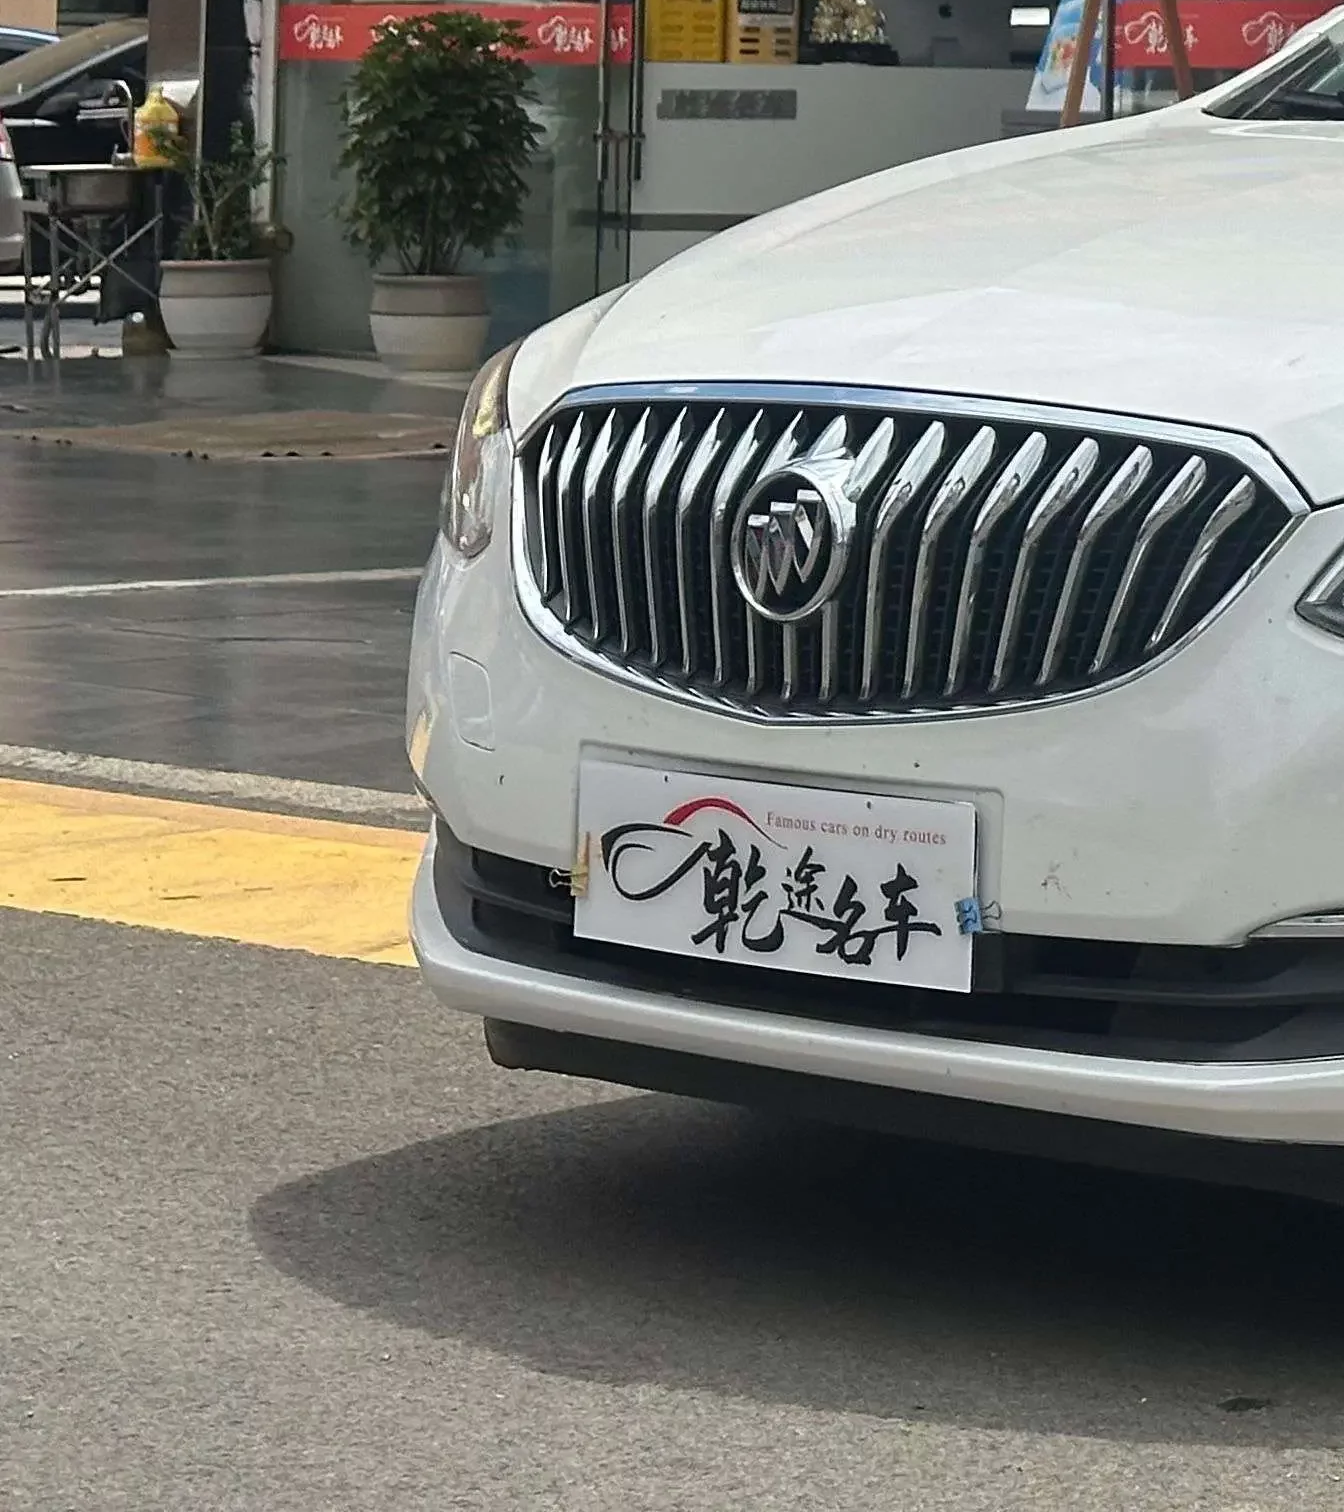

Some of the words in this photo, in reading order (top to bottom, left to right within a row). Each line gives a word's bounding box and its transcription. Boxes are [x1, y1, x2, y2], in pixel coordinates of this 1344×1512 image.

[766, 811, 817, 832] Famous
[820, 820, 849, 835] cars
[852, 824, 870, 838] on
[874, 823, 899, 845] dry
[902, 829, 947, 846] routes
[690, 828, 943, 966] 乾途名车
